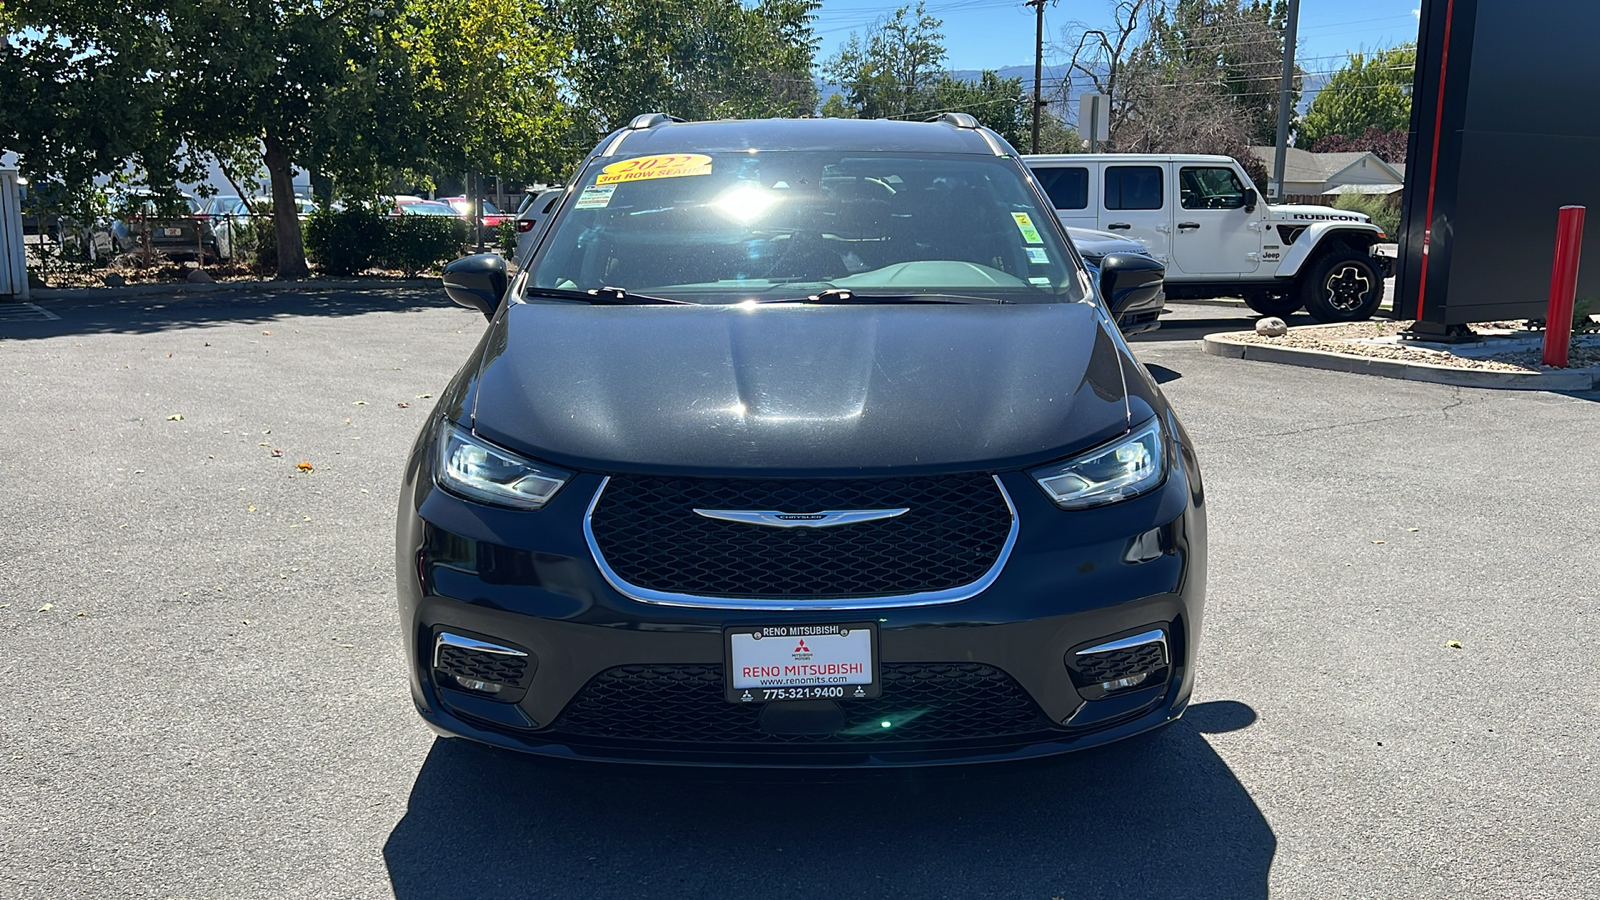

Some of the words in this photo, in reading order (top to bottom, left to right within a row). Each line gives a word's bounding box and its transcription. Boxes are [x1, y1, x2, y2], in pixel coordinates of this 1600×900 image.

[620, 156, 692, 172] 2022
[599, 174, 622, 183] 3rd
[624, 171, 655, 180] ROW
[1293, 213, 1359, 222] RUBICON
[1262, 251, 1280, 259] Jeep
[763, 627, 787, 636] RENO
[789, 626, 839, 636] MITSUBISHI
[742, 666, 780, 677] RENO
[784, 663, 863, 676] MITSUBISHI
[760, 676, 848, 685] www.renomits.com
[763, 687, 844, 699] 775-321-9400
